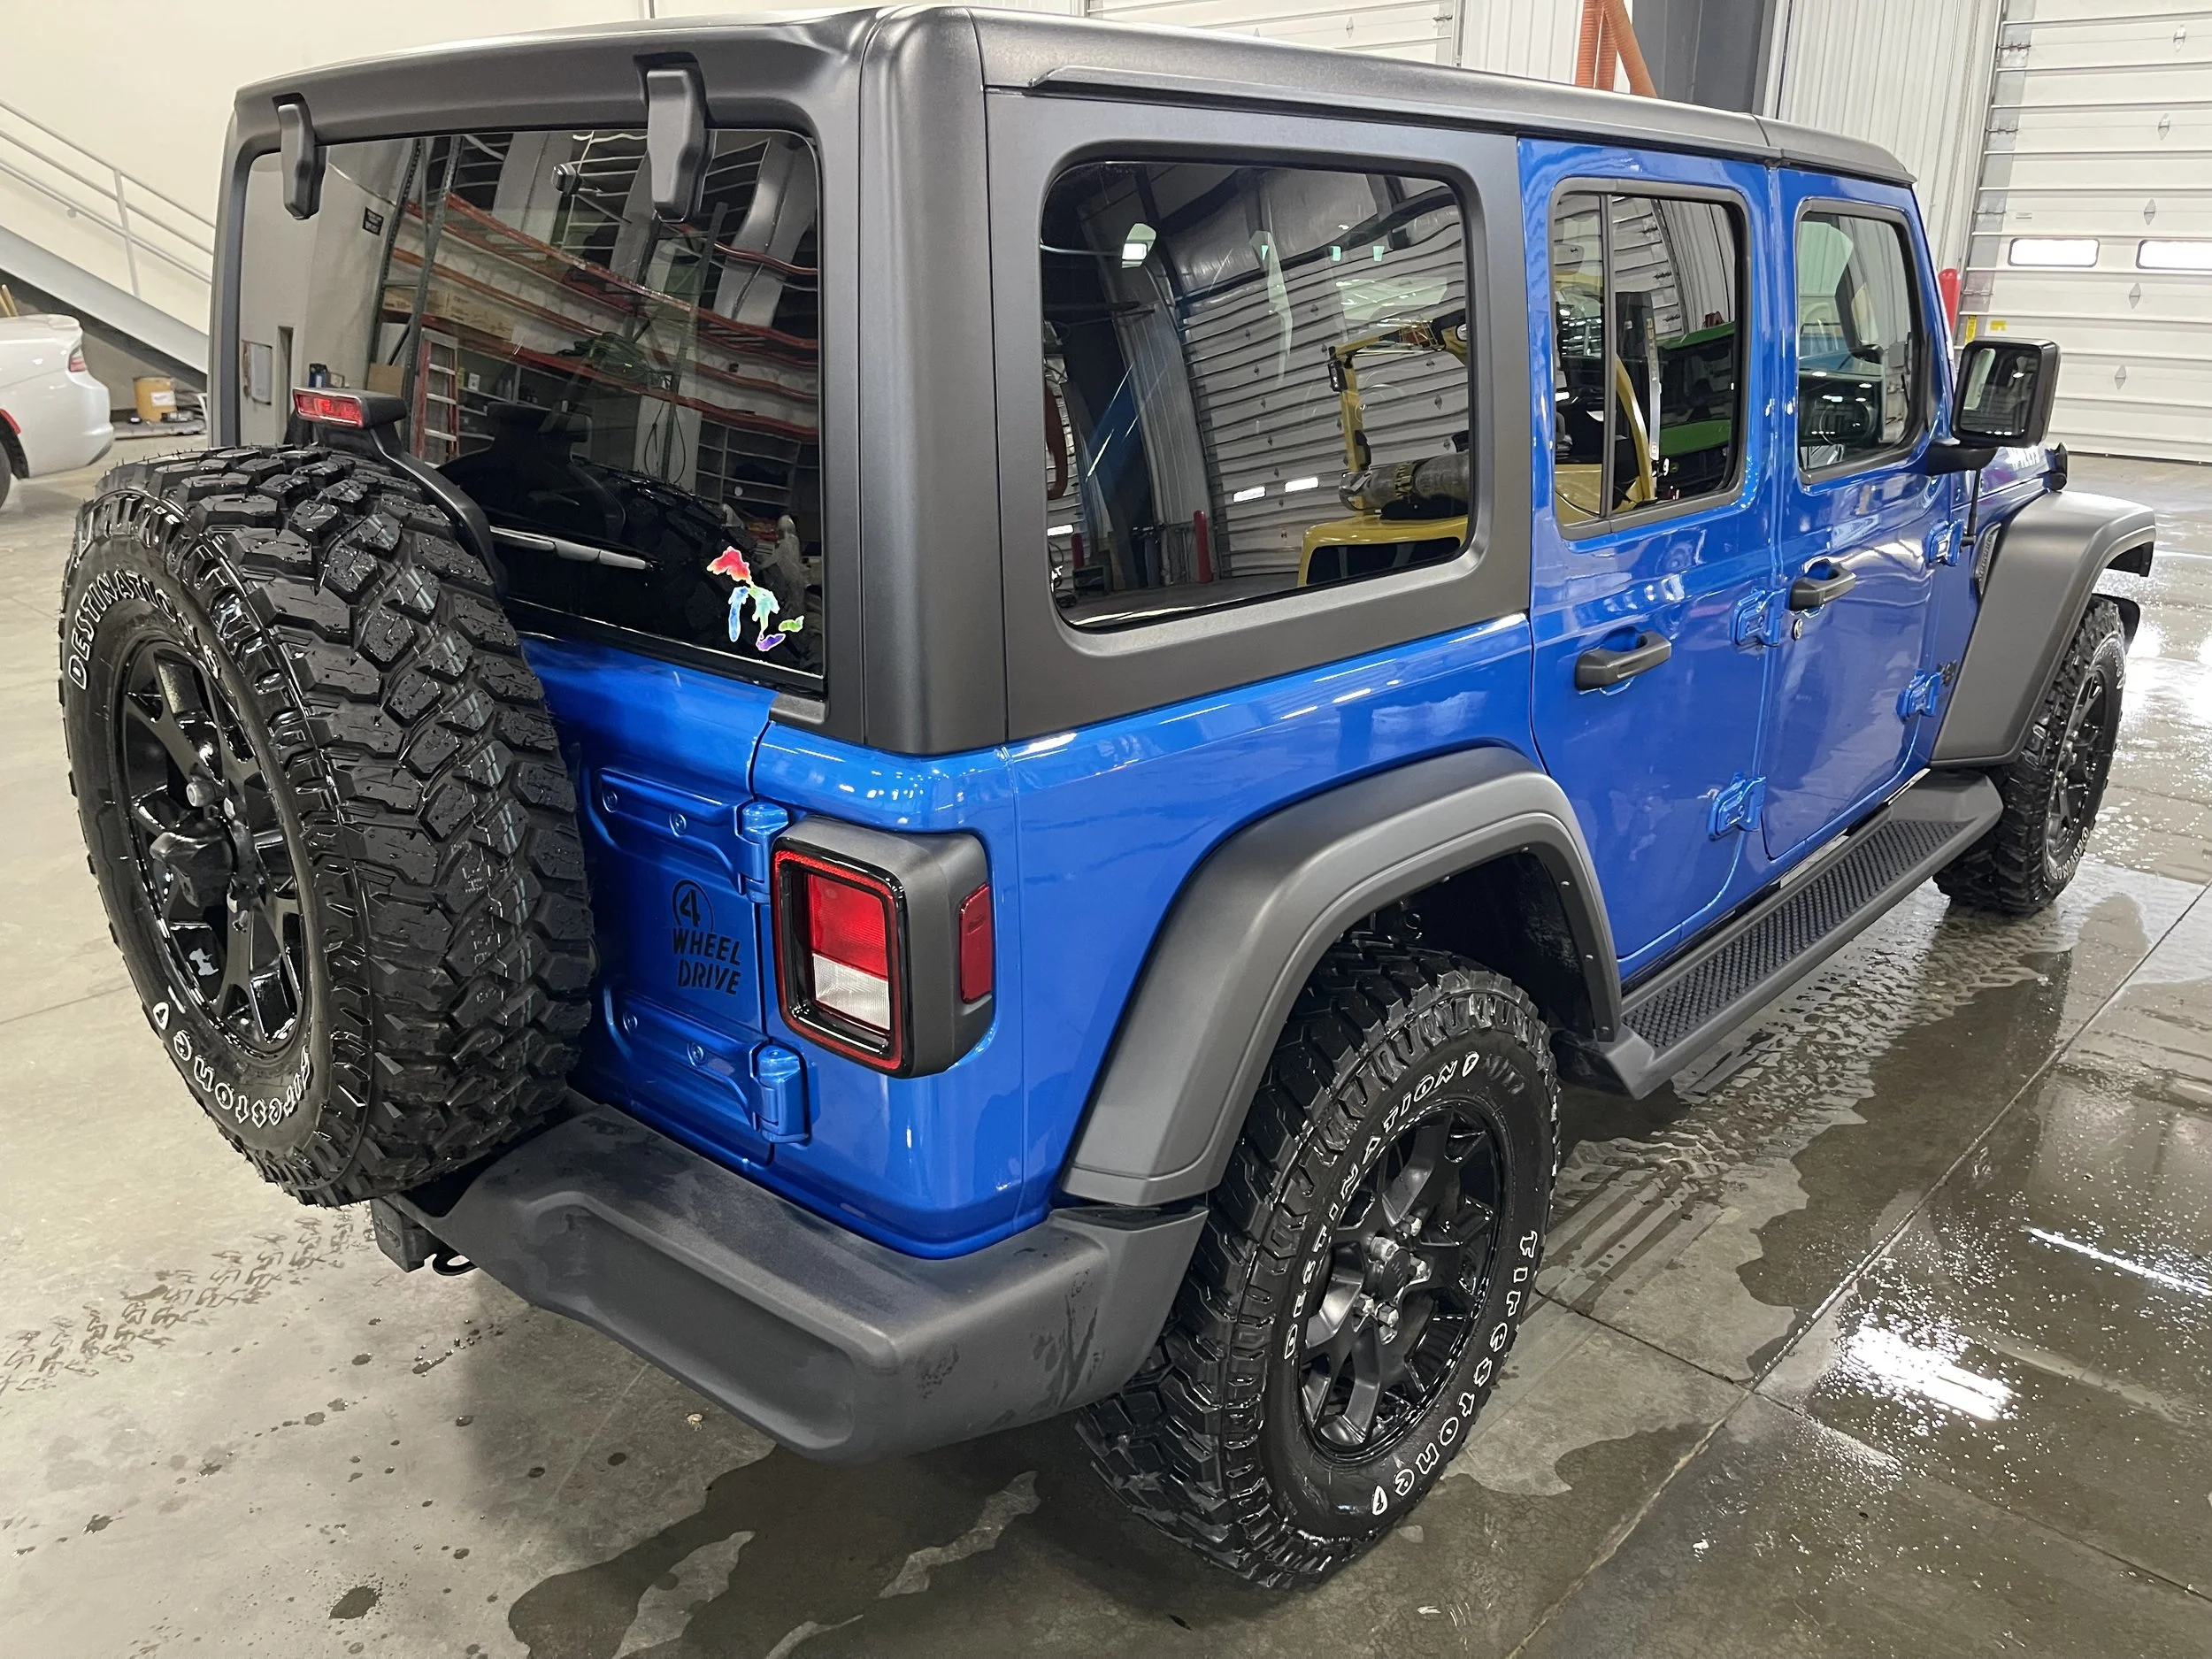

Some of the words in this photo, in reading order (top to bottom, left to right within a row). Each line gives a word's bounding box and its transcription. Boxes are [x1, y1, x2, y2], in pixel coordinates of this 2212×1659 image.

[679, 888, 701, 927] 4
[672, 926, 741, 966] WHEEL
[678, 958, 741, 995] DRIVE
[1284, 1060, 1458, 1360] DESTINATION
